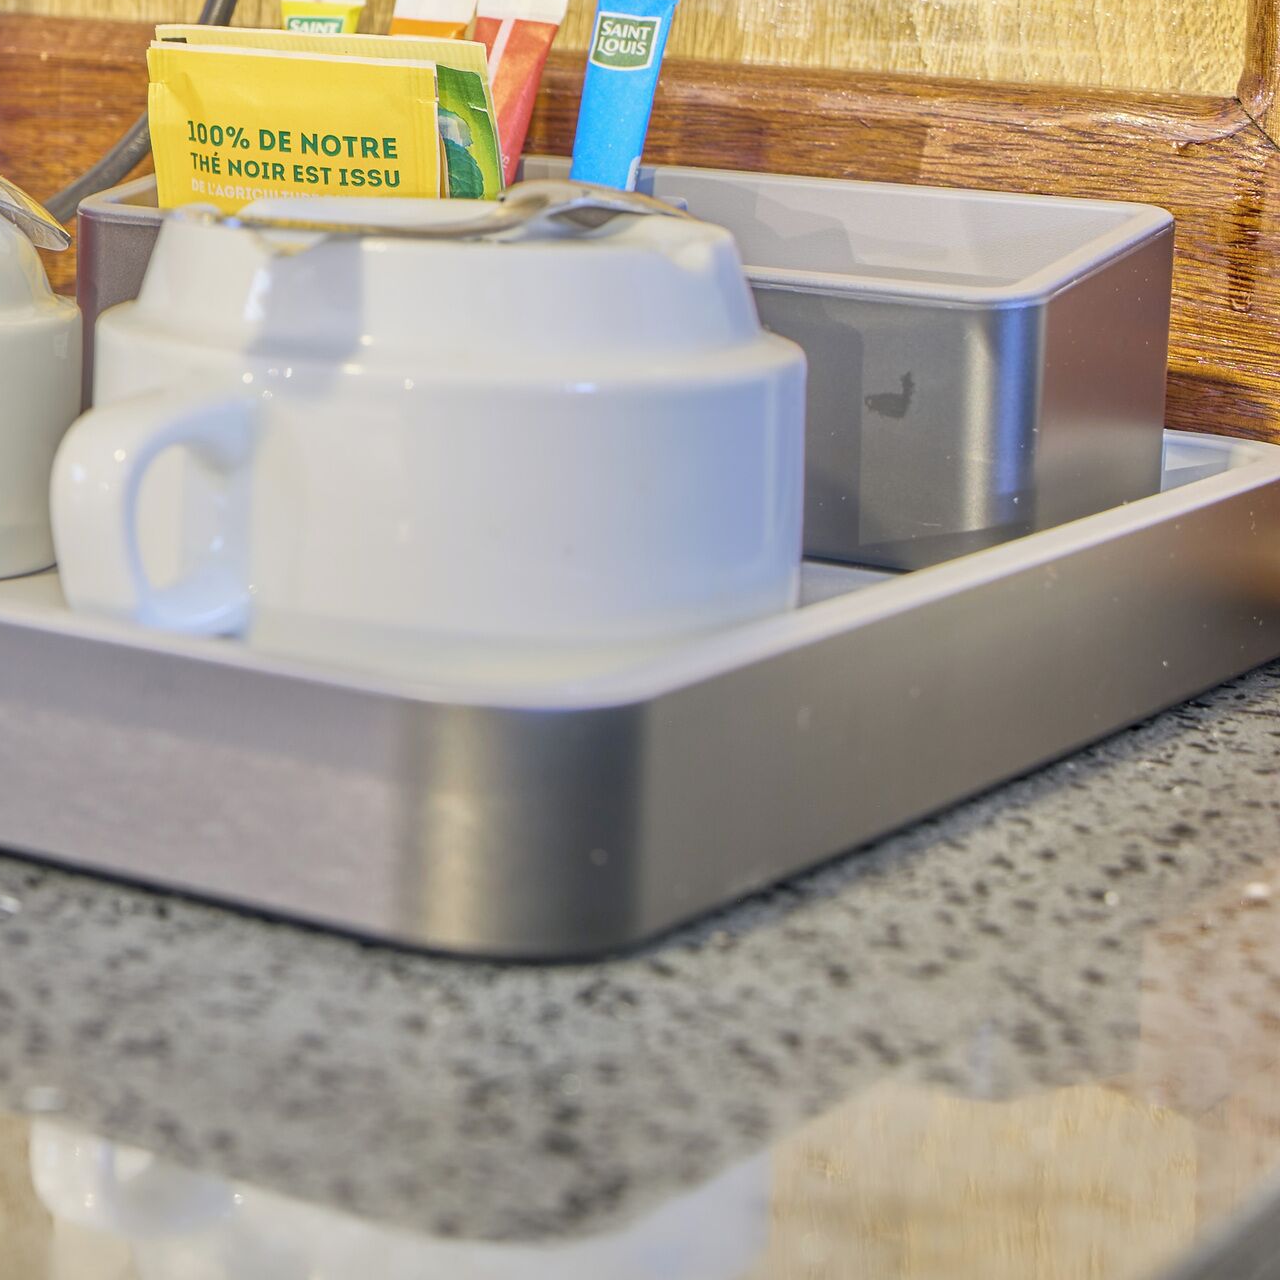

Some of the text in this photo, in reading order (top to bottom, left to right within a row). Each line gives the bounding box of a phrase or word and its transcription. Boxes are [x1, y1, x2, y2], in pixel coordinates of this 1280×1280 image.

[290, 19, 339, 33] SAINT
[600, 20, 651, 41] SAINT
[597, 36, 647, 56] LOUIS
[187, 120, 399, 160] 100% DE NOTRE
[190, 151, 401, 188] THÉ NOIR EST ISSU
[191, 178, 206, 194] DE
